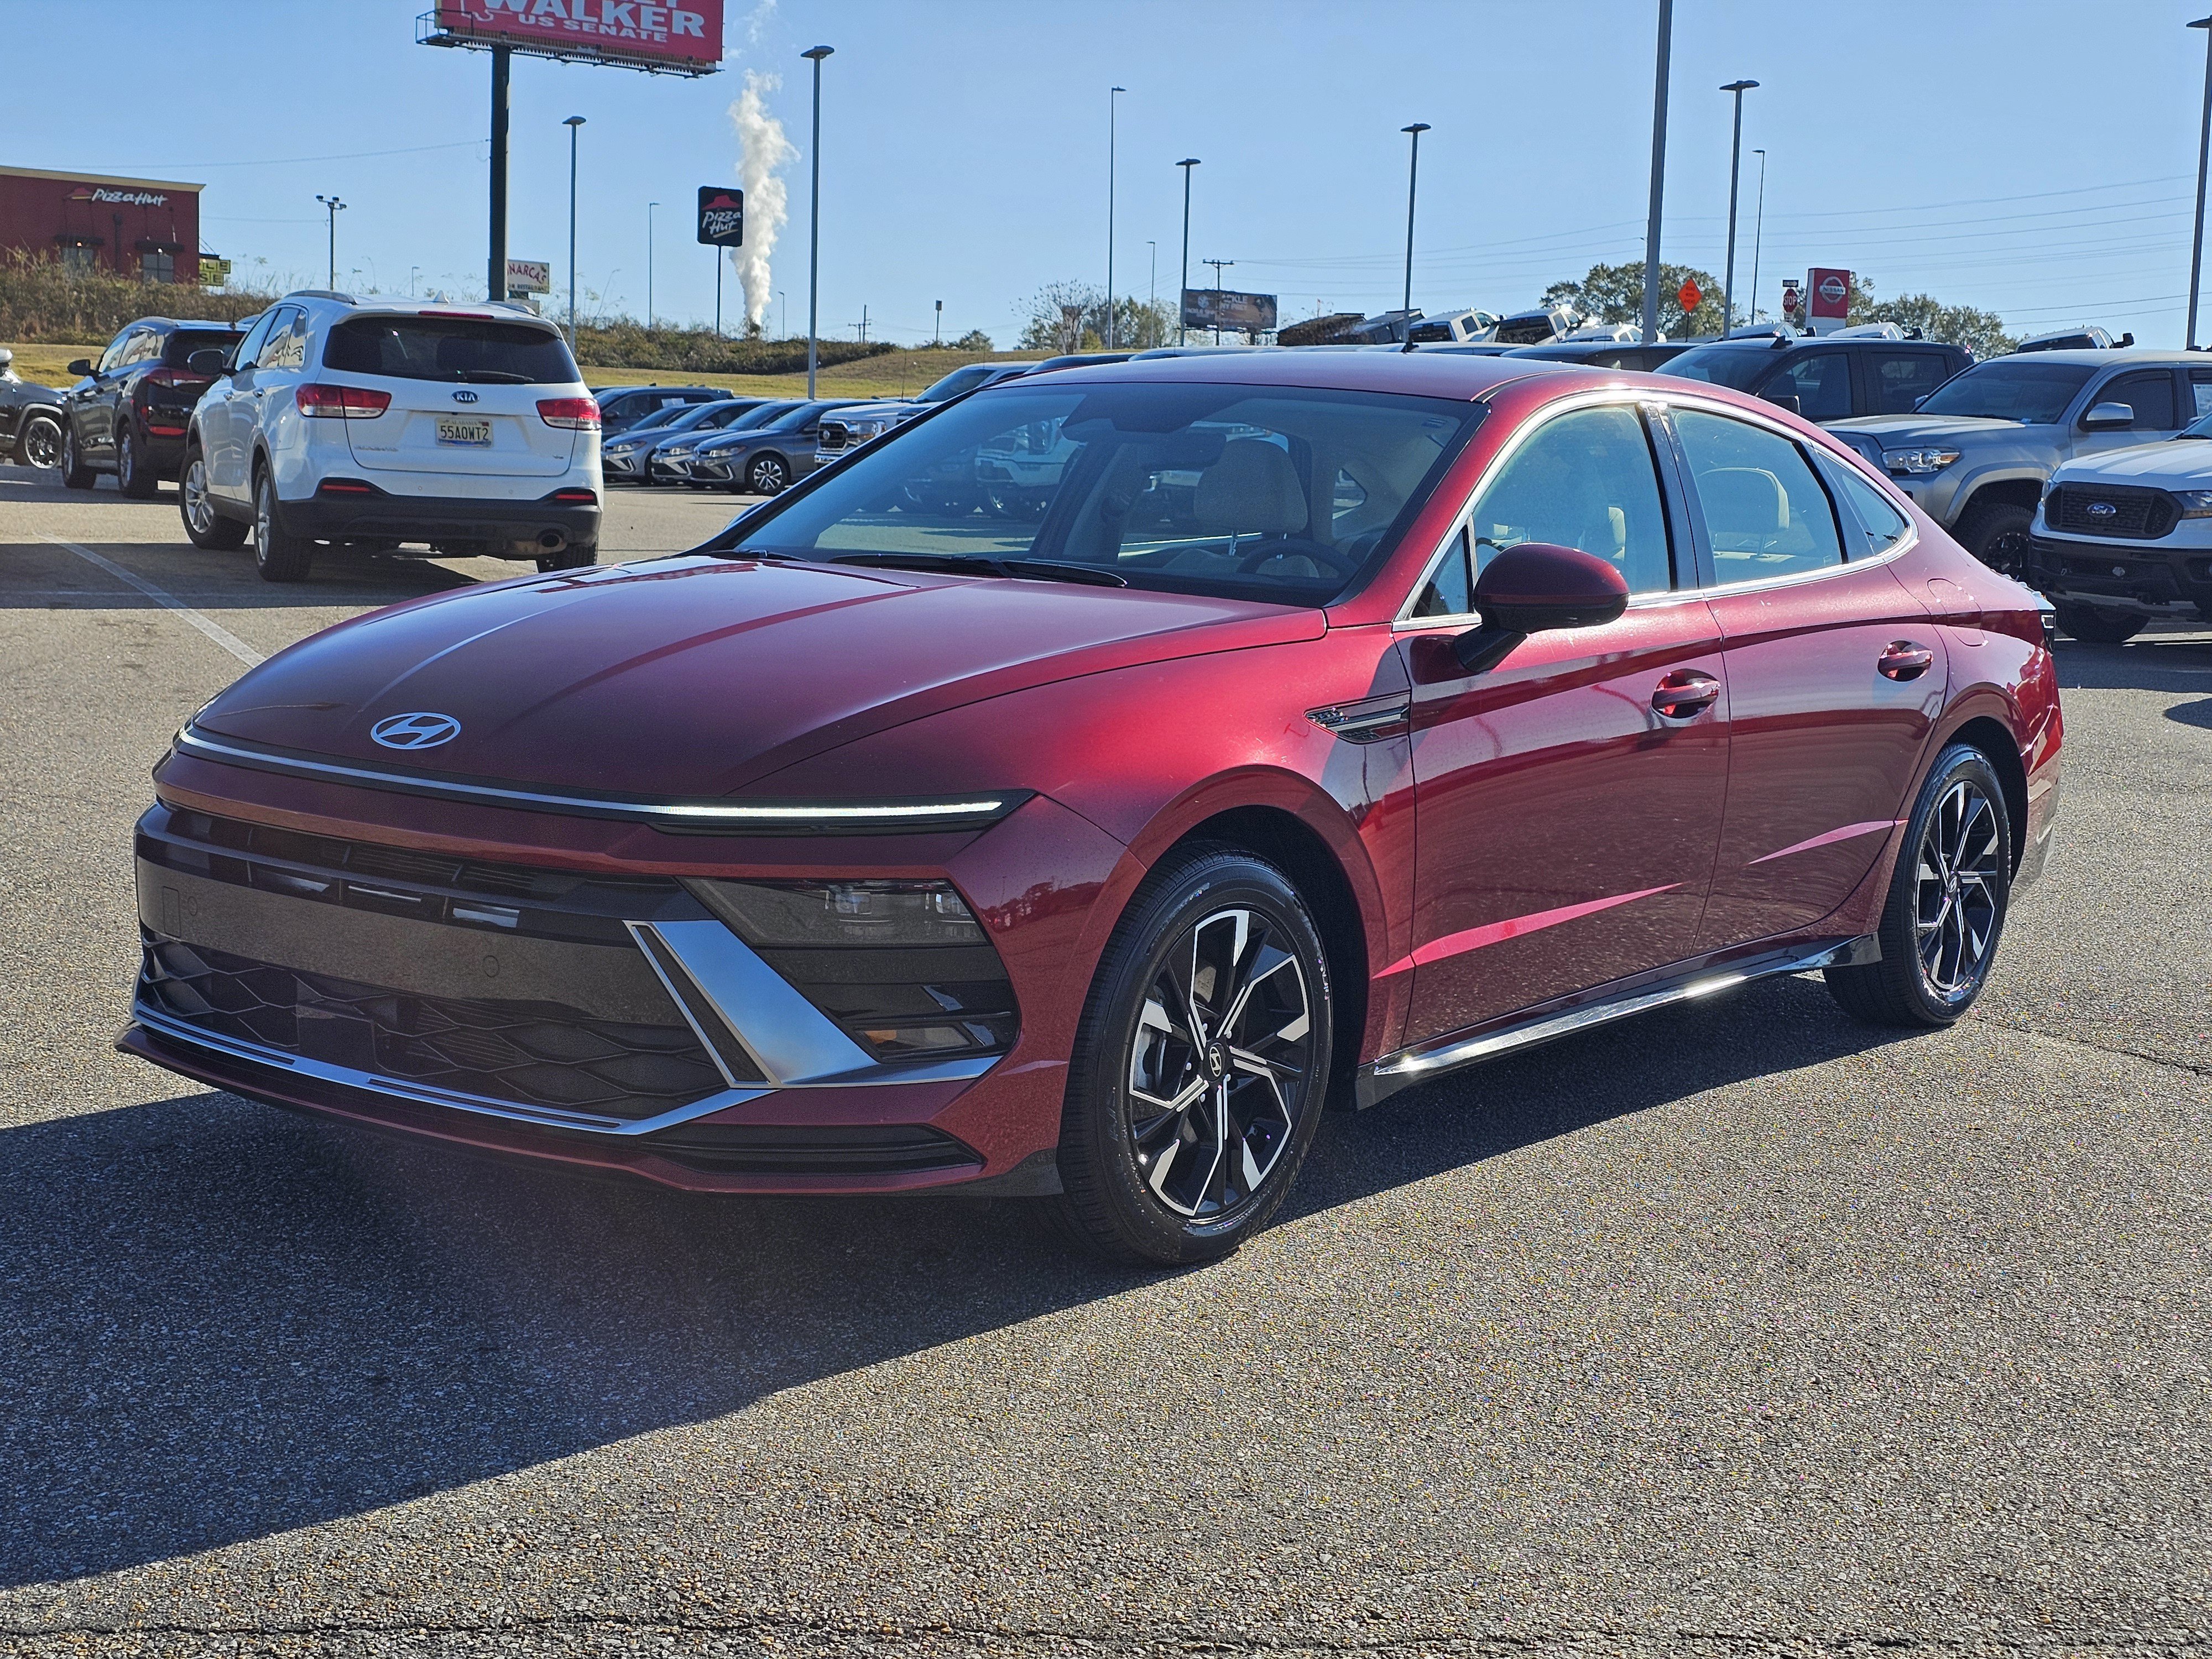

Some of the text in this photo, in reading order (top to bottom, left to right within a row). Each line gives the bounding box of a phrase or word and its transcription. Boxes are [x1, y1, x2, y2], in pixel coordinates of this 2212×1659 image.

[518, 13, 555, 27] US
[563, 19, 667, 43] SENATE
[92, 188, 168, 207] Pizza Hut
[702, 211, 742, 229] Pizza
[709, 220, 738, 235] Hut
[1784, 295, 1797, 306] STOP
[456, 392, 476, 401] KIA
